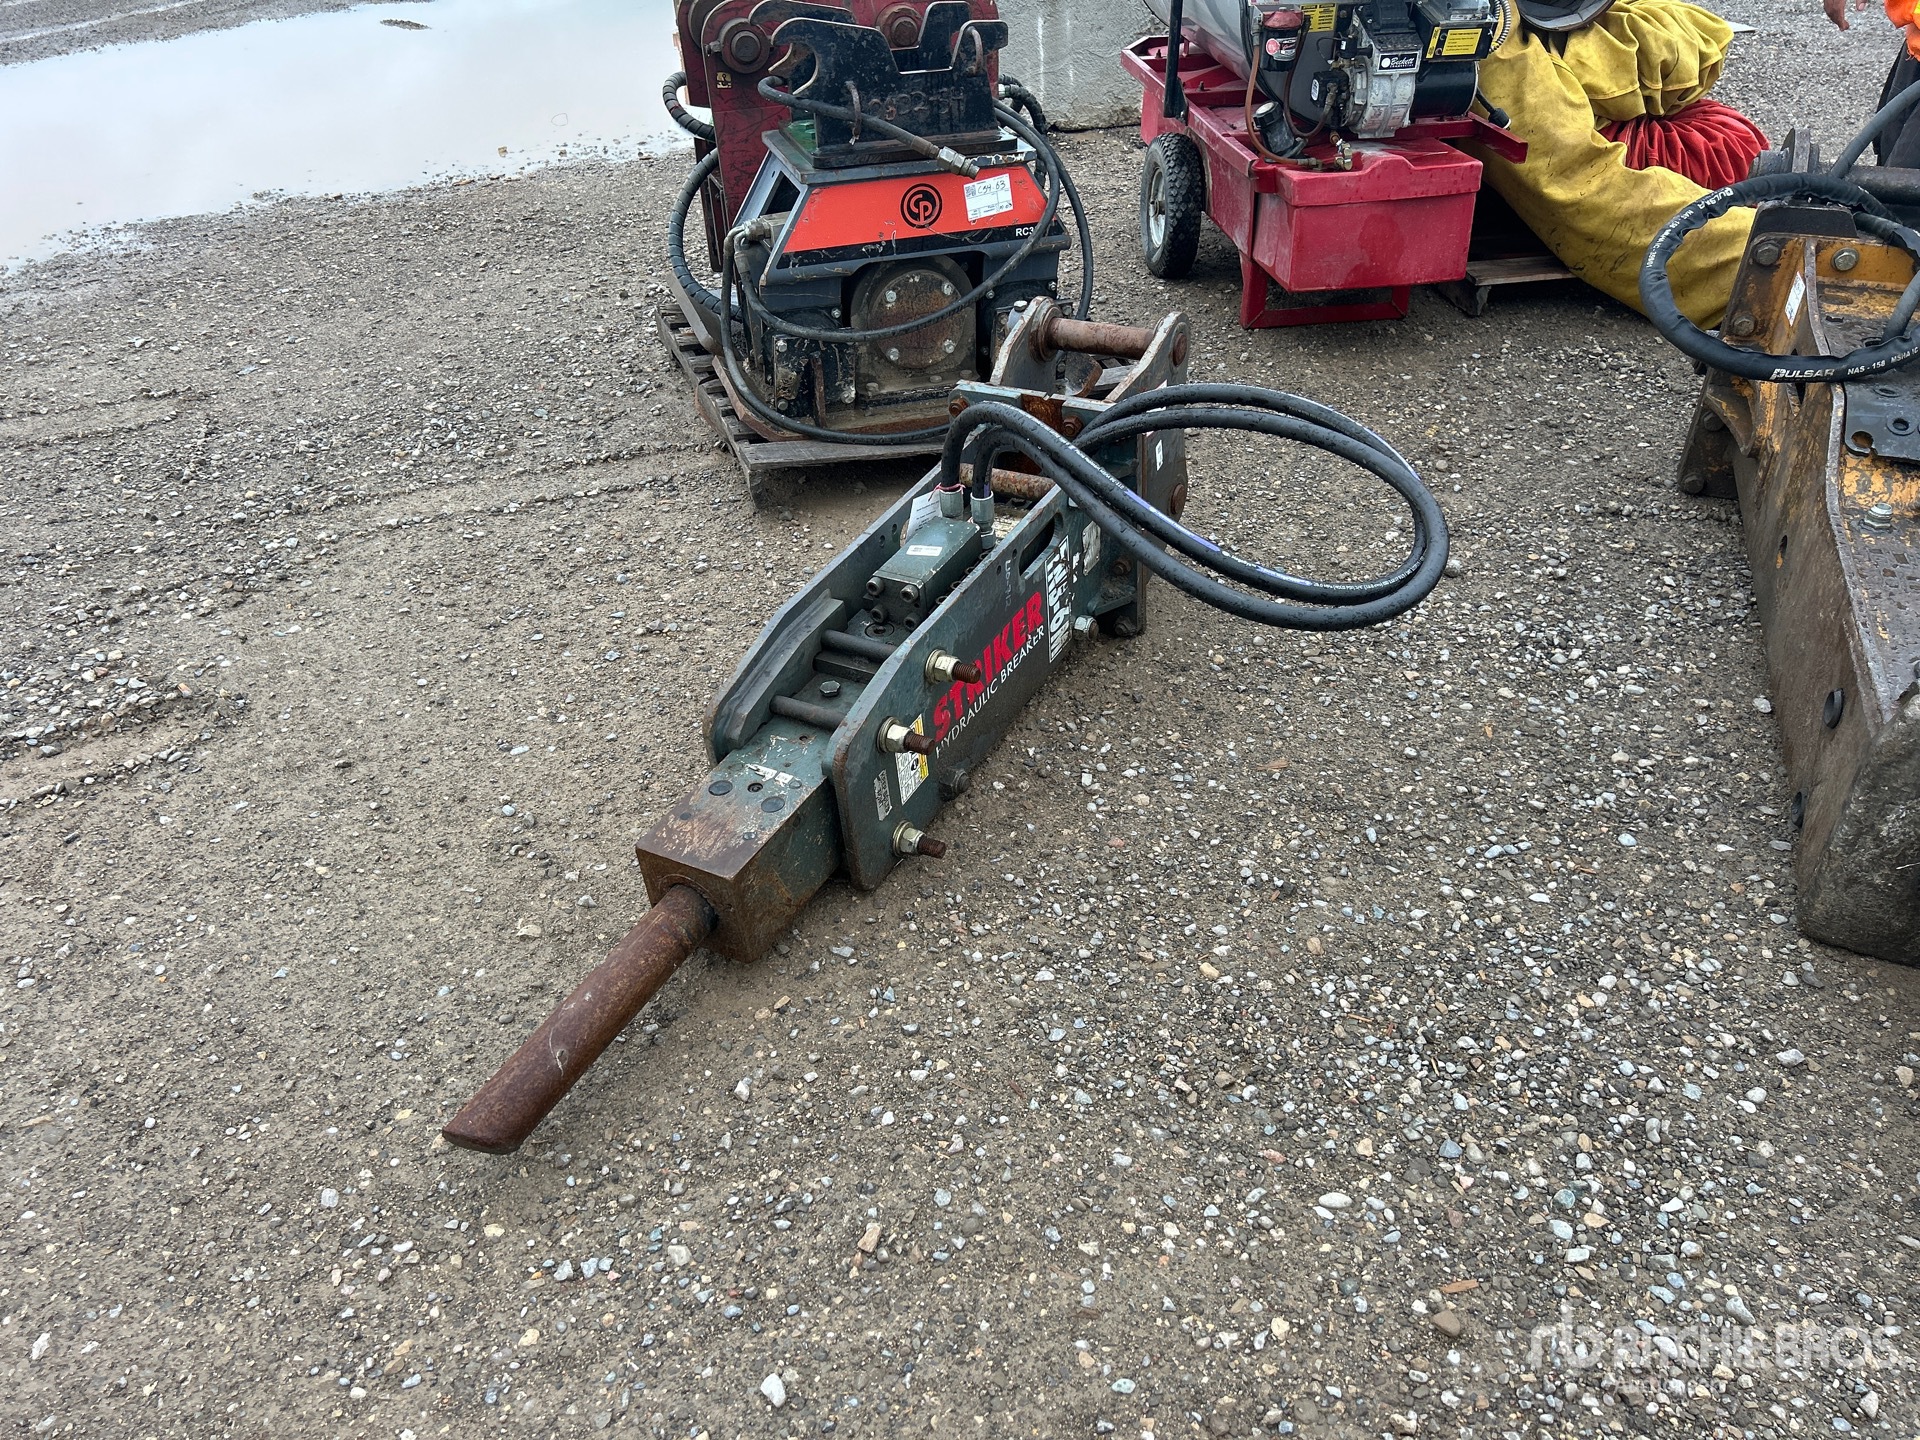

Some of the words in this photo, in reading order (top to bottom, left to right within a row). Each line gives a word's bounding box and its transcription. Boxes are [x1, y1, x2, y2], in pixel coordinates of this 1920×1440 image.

[1015, 226, 1034, 237] RC3
[1769, 367, 1835, 380] PULSAR
[1847, 364, 1865, 376] NAS
[1872, 360, 1886, 370] 158
[933, 591, 1046, 743] STRIKER
[935, 678, 998, 759] HYDRAULIC
[1000, 624, 1046, 684] BREAKER
